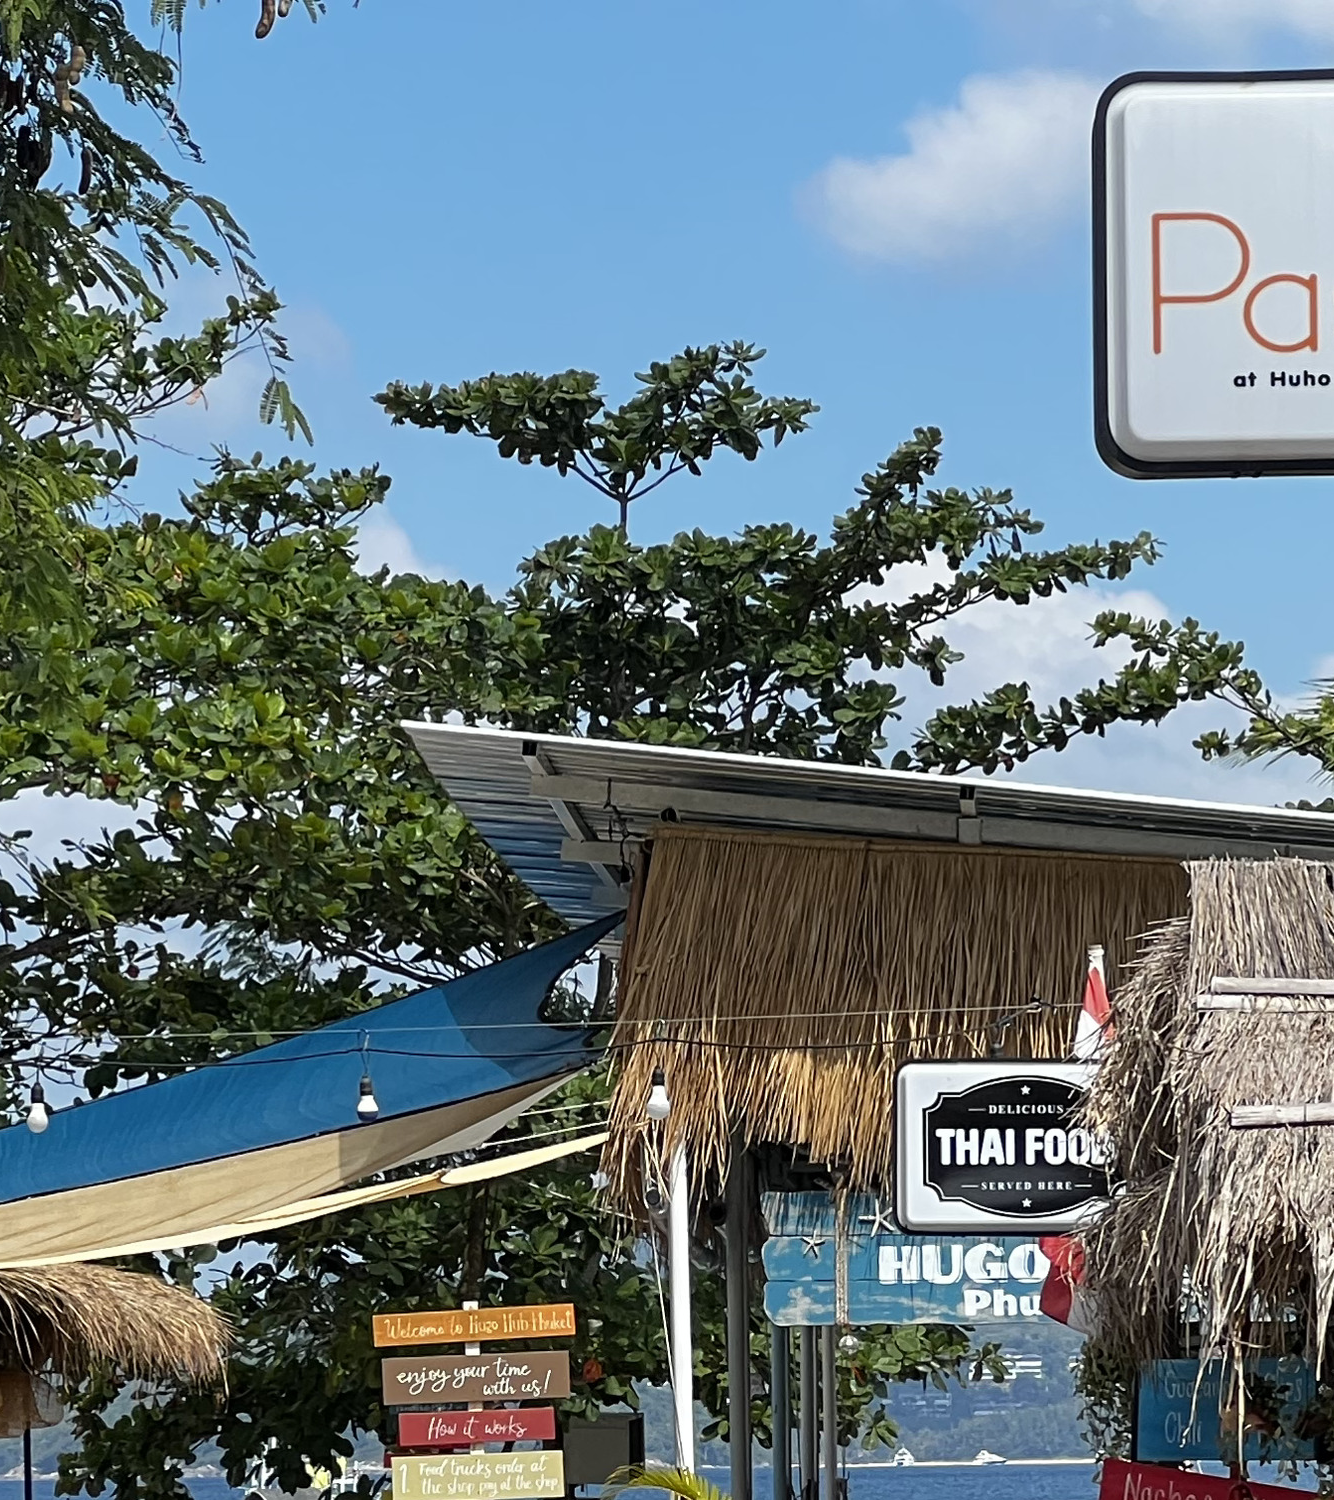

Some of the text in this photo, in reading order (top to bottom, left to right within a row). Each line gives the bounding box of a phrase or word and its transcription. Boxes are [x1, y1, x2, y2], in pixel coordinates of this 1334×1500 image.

[1233, 372, 1257, 388] at
[1270, 370, 1331, 387] Huho
[988, 1104, 1065, 1114] DELICIOUS
[935, 1128, 1015, 1166] THAI
[981, 1181, 1072, 1190] SERVED HERE
[878, 1243, 1051, 1286] HUGO
[449, 1316, 463, 1334] to
[396, 1357, 531, 1395] enjoy your time
[482, 1369, 552, 1397] with us!
[428, 1415, 527, 1440] How it works
[418, 1459, 446, 1477] Food
[451, 1459, 491, 1478] trucks
[495, 1457, 524, 1475] order
[529, 1455, 547, 1472] at
